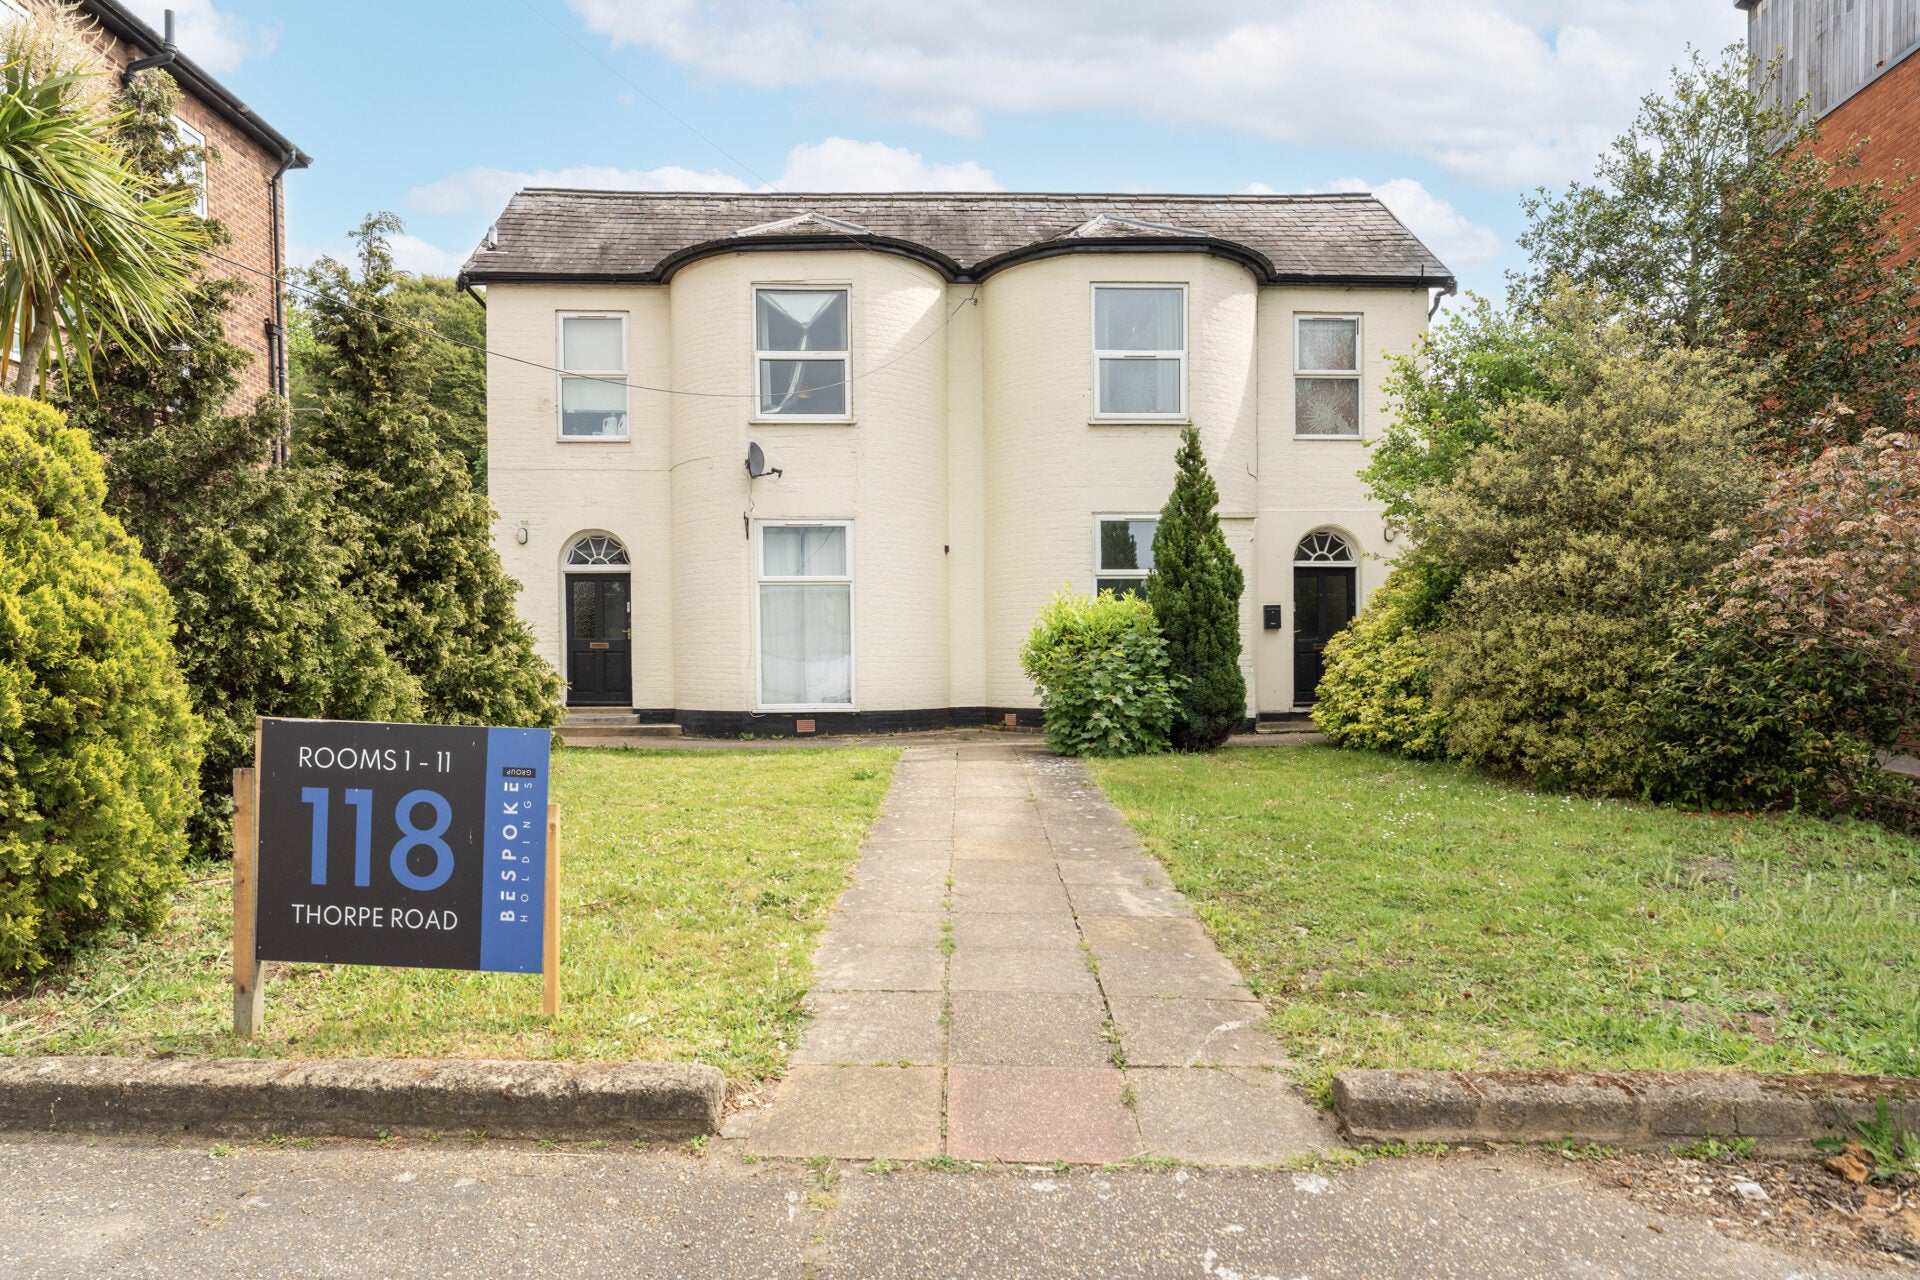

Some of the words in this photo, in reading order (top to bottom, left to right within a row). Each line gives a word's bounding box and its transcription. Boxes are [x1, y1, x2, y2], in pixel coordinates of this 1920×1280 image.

[298, 746, 397, 771] ROOMS
[404, 750, 411, 771] 1
[437, 751, 451, 773] 11
[506, 768, 532, 777] GROUP
[301, 787, 455, 892] 118
[500, 782, 520, 922] BESPOKE
[520, 782, 533, 923] HOLDINGS
[291, 903, 384, 928] THORPE
[390, 908, 458, 931] ROAD
